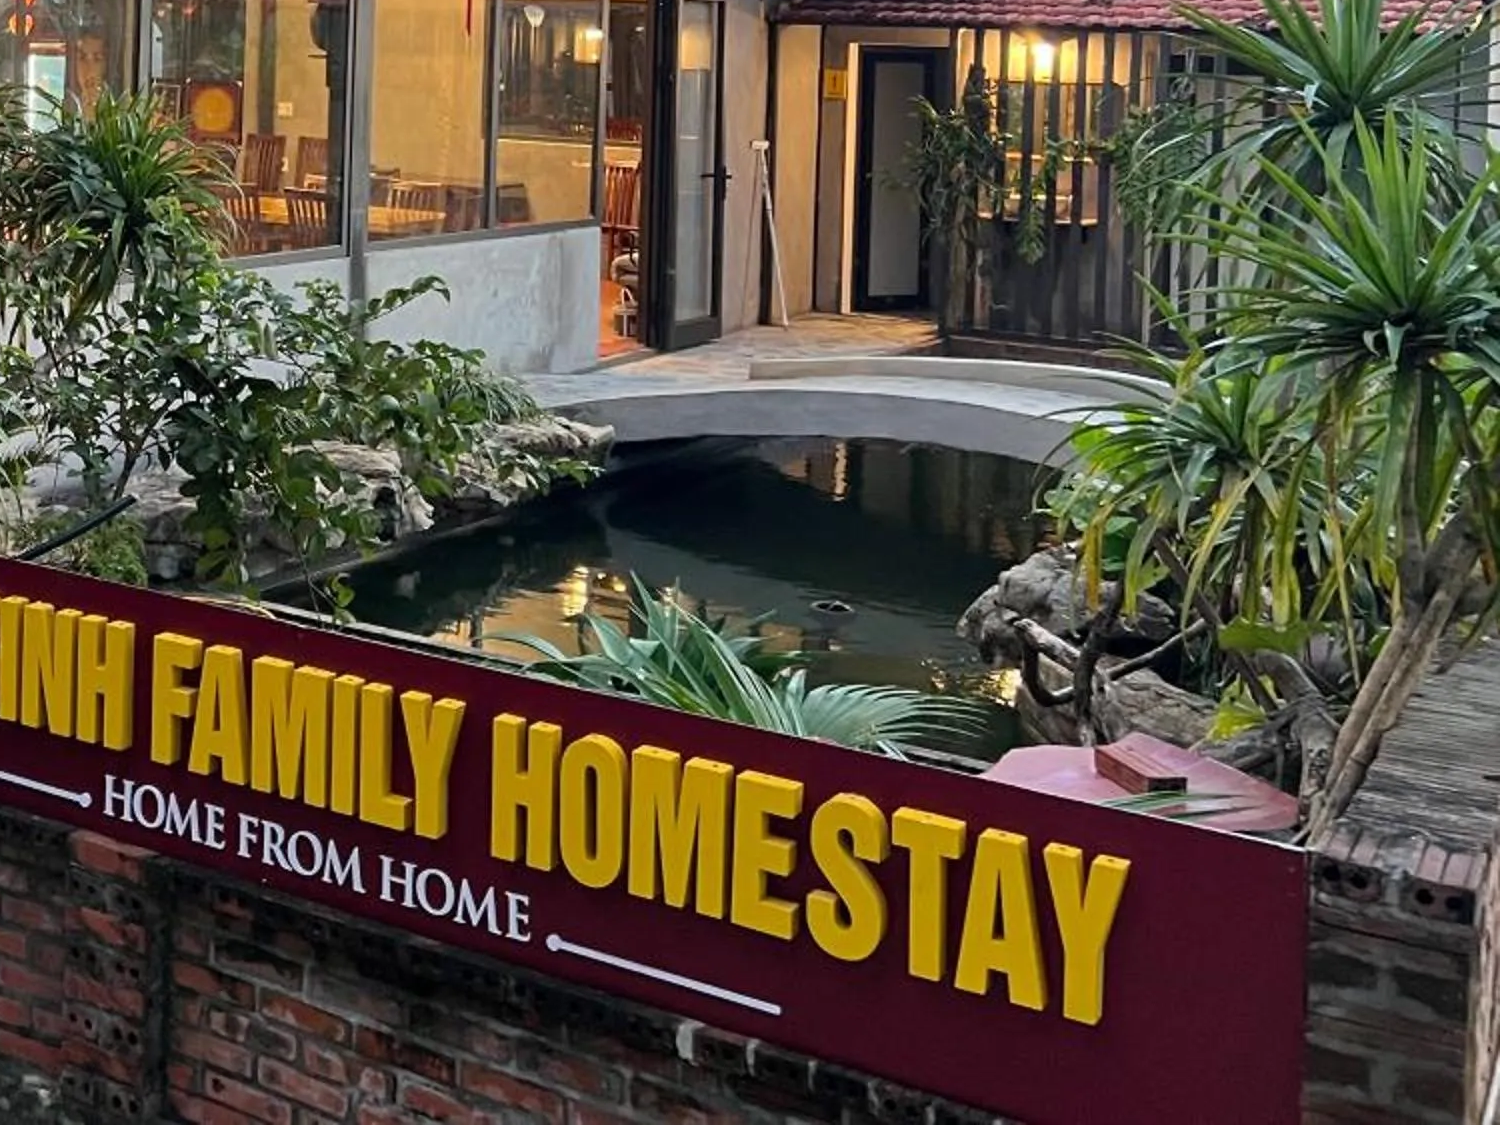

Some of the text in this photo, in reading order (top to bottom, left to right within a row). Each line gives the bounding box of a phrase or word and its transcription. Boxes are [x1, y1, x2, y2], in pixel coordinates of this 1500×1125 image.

[103, 774, 532, 943] HOME FROM HOME
[150, 631, 467, 840] FAMILY
[490, 711, 1132, 1026] HOMESTAY
